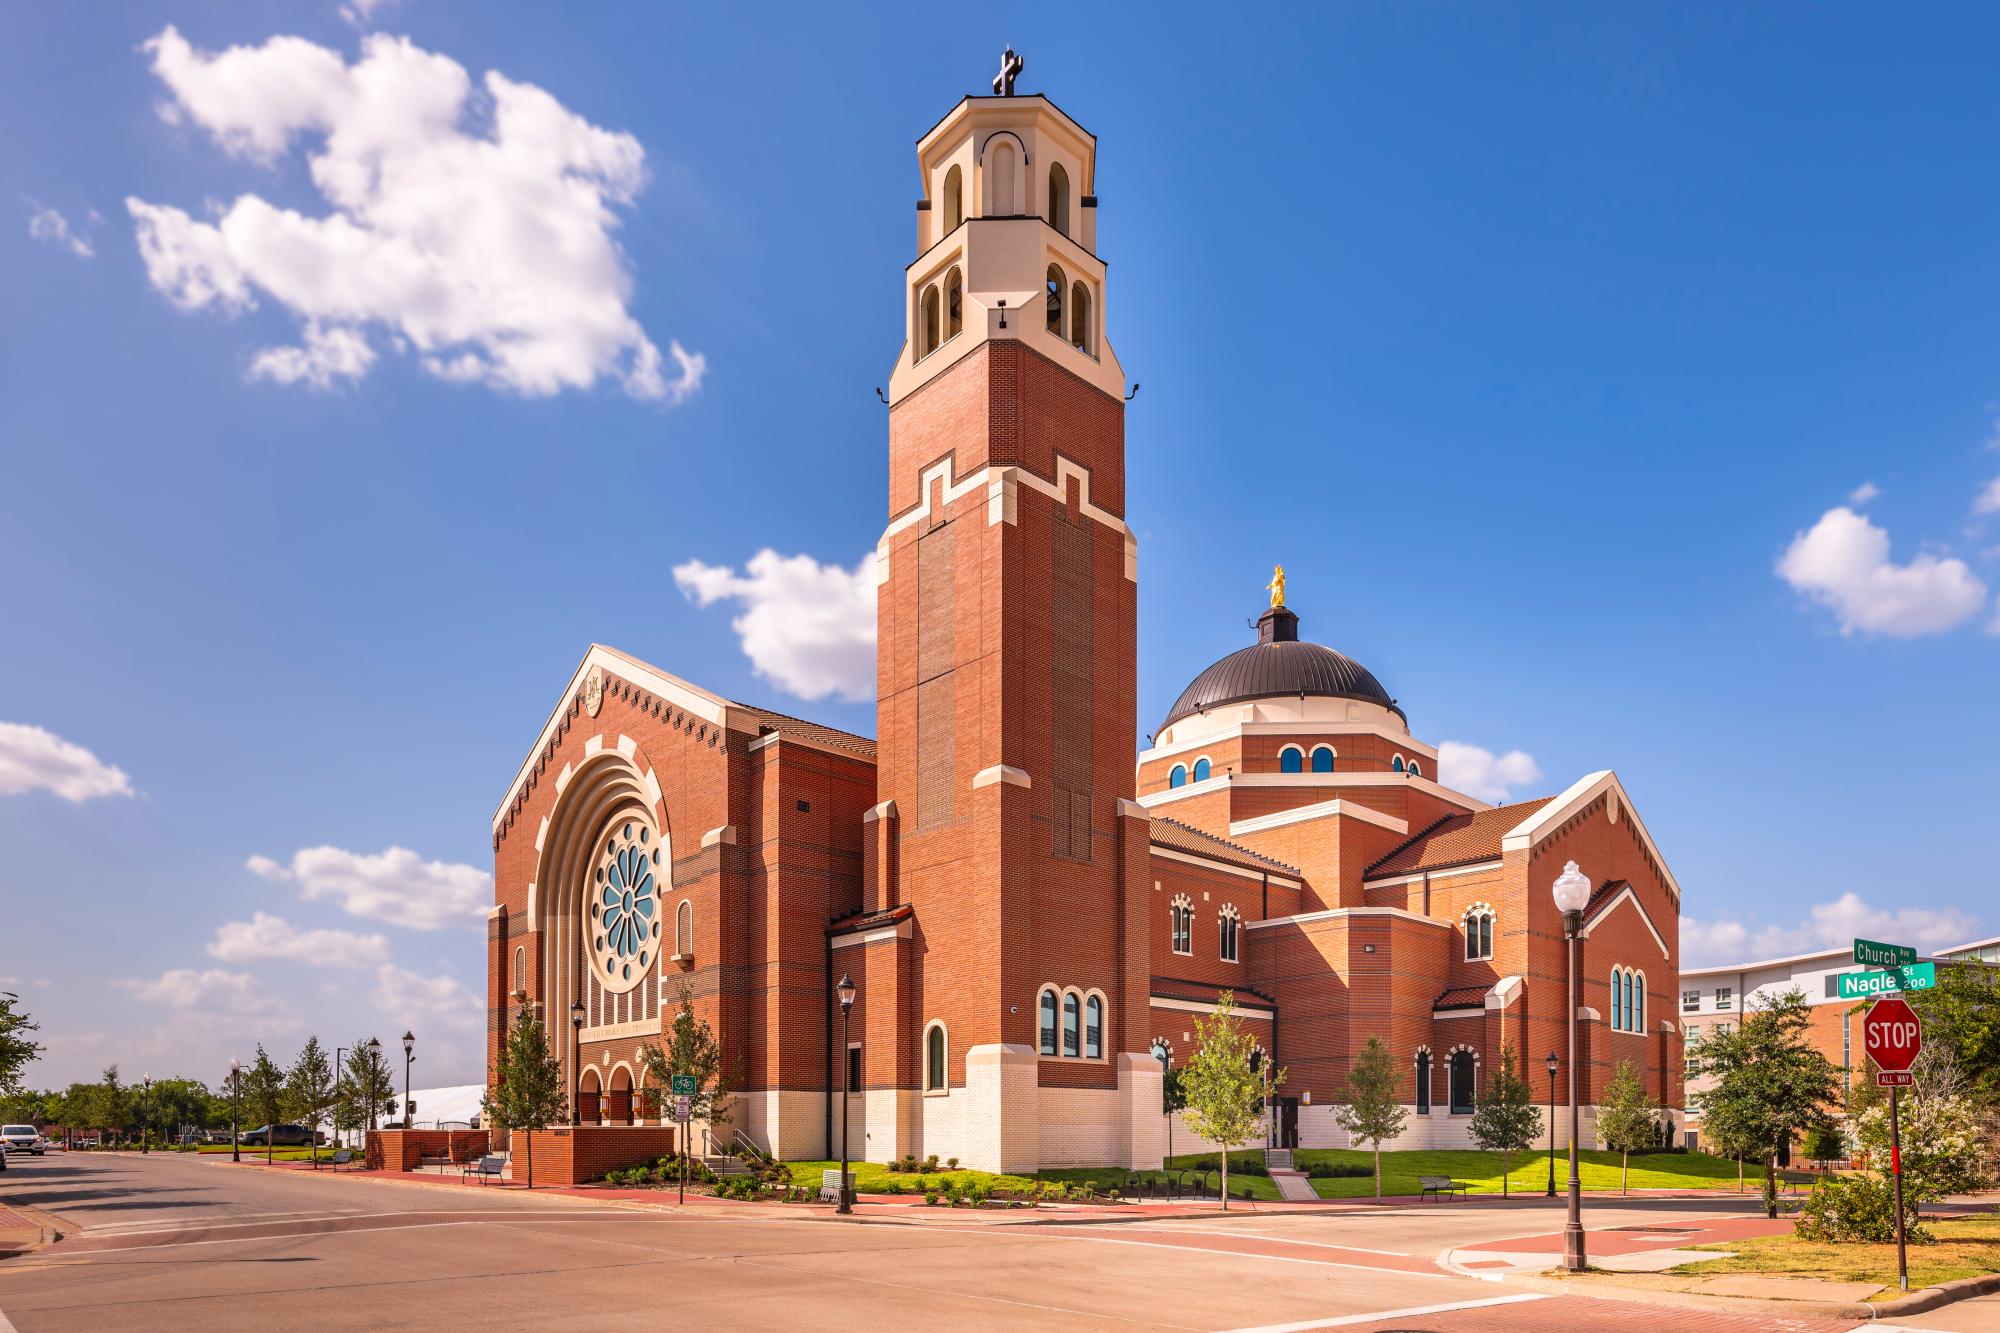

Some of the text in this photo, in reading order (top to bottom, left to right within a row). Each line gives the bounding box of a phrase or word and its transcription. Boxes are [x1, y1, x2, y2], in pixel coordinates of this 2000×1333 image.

[1858, 943, 1910, 965] Church Ave
[1846, 967, 1914, 994] Nagle St
[1903, 977, 1926, 989] 200
[1868, 1022, 1917, 1049] STOP
[1881, 1074, 1910, 1084] ALL WAY
